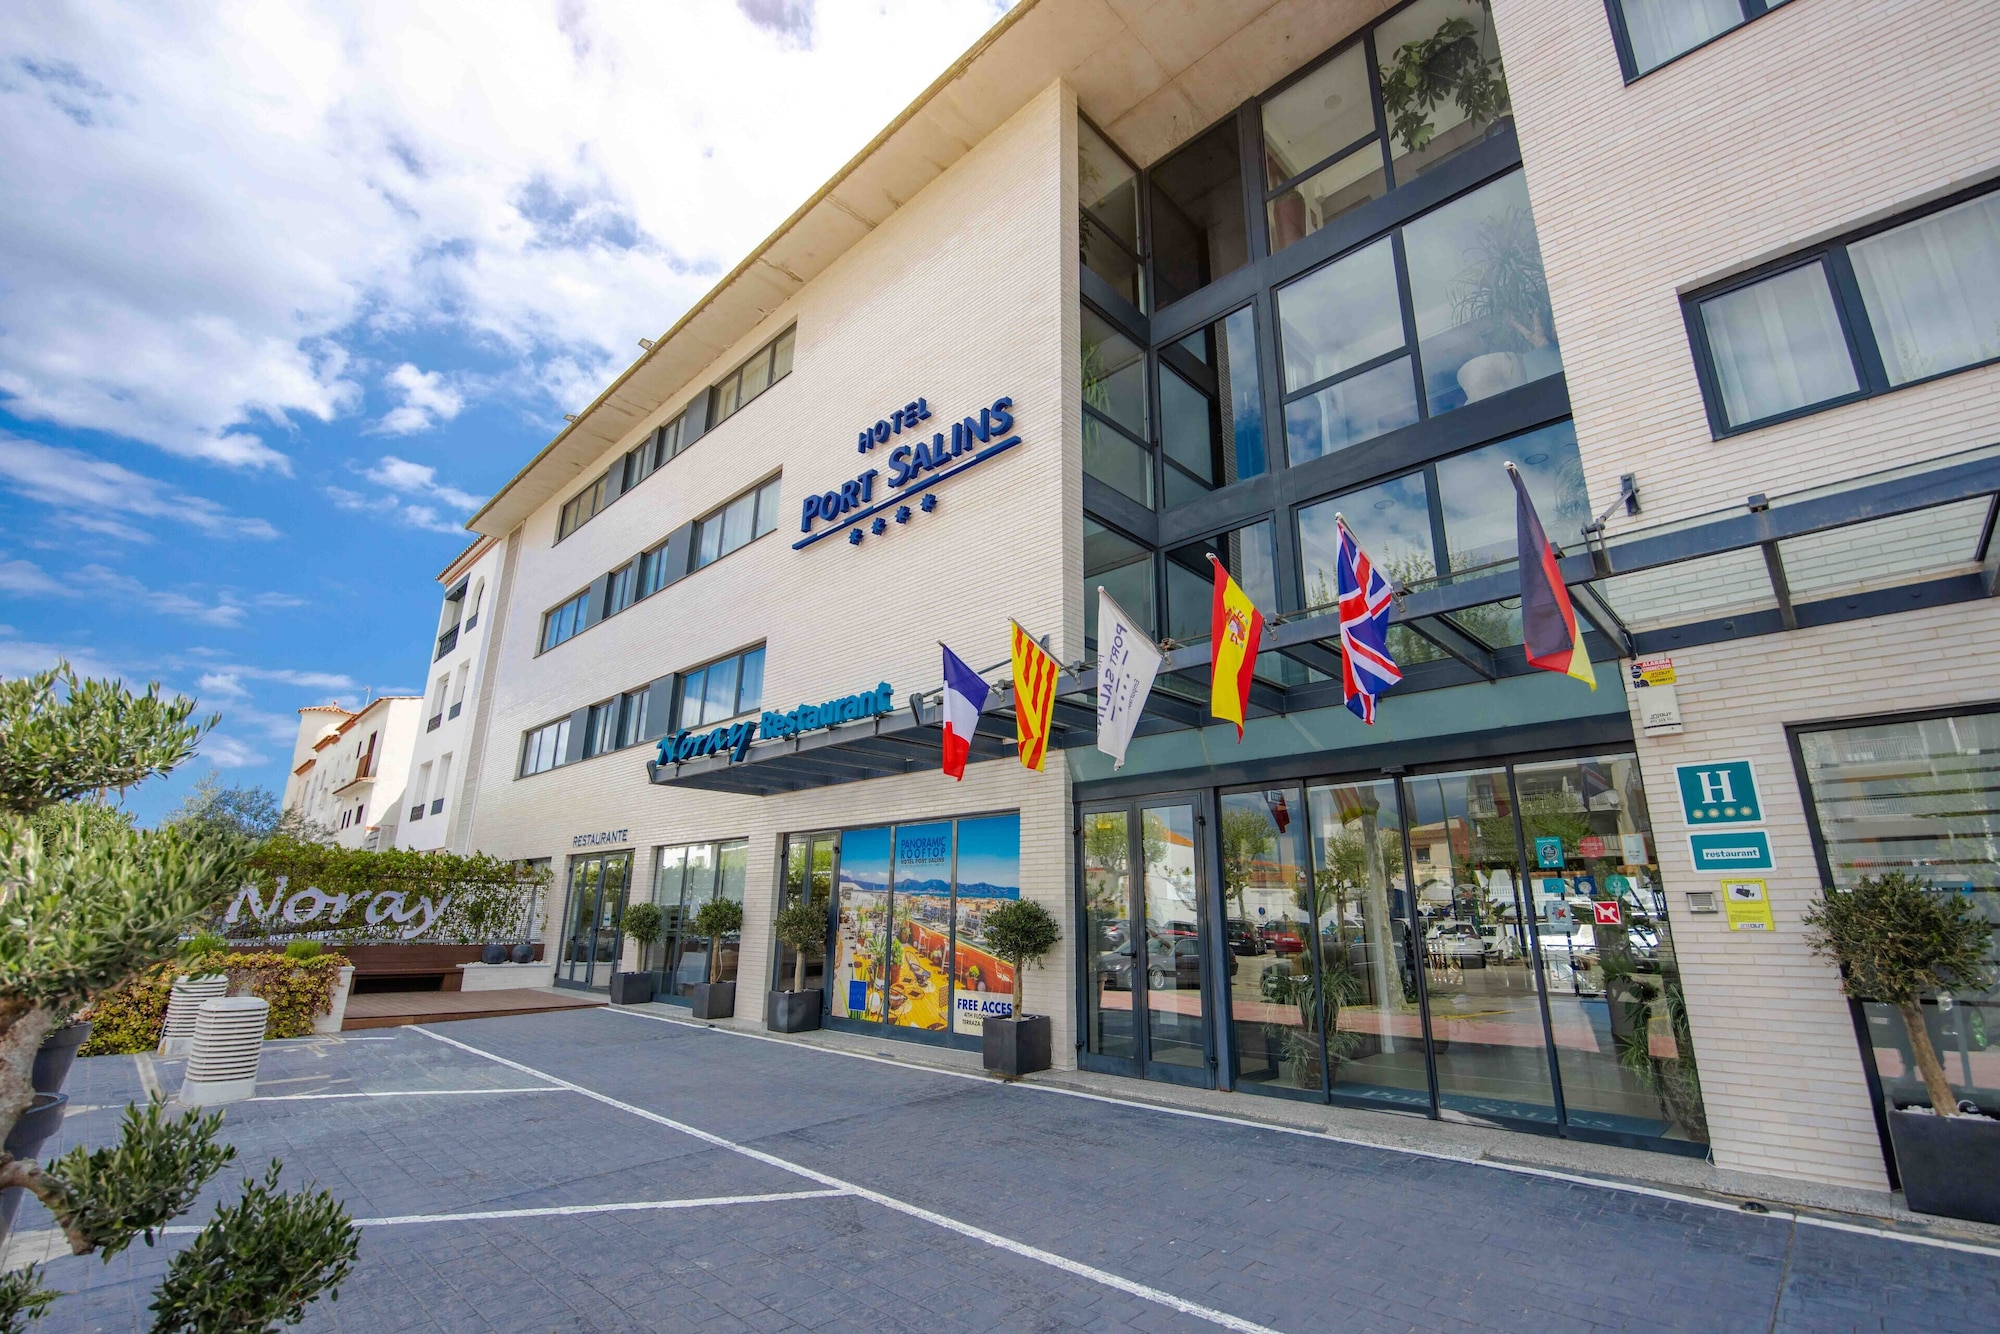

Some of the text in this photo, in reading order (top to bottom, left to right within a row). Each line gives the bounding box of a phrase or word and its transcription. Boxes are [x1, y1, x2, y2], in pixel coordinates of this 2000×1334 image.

[857, 397, 932, 454] HOTEL
[801, 396, 1013, 533] PORT SALINS
[656, 680, 894, 766] Noray Restaurant
[1696, 770, 1737, 804] H
[573, 829, 628, 848] RESTAURANTE
[901, 836, 946, 849] PANORAMIC
[900, 847, 946, 859] ROOFTOP
[1705, 849, 1758, 858] restaurant
[225, 875, 451, 940] Noray
[957, 998, 978, 1011] FREE
